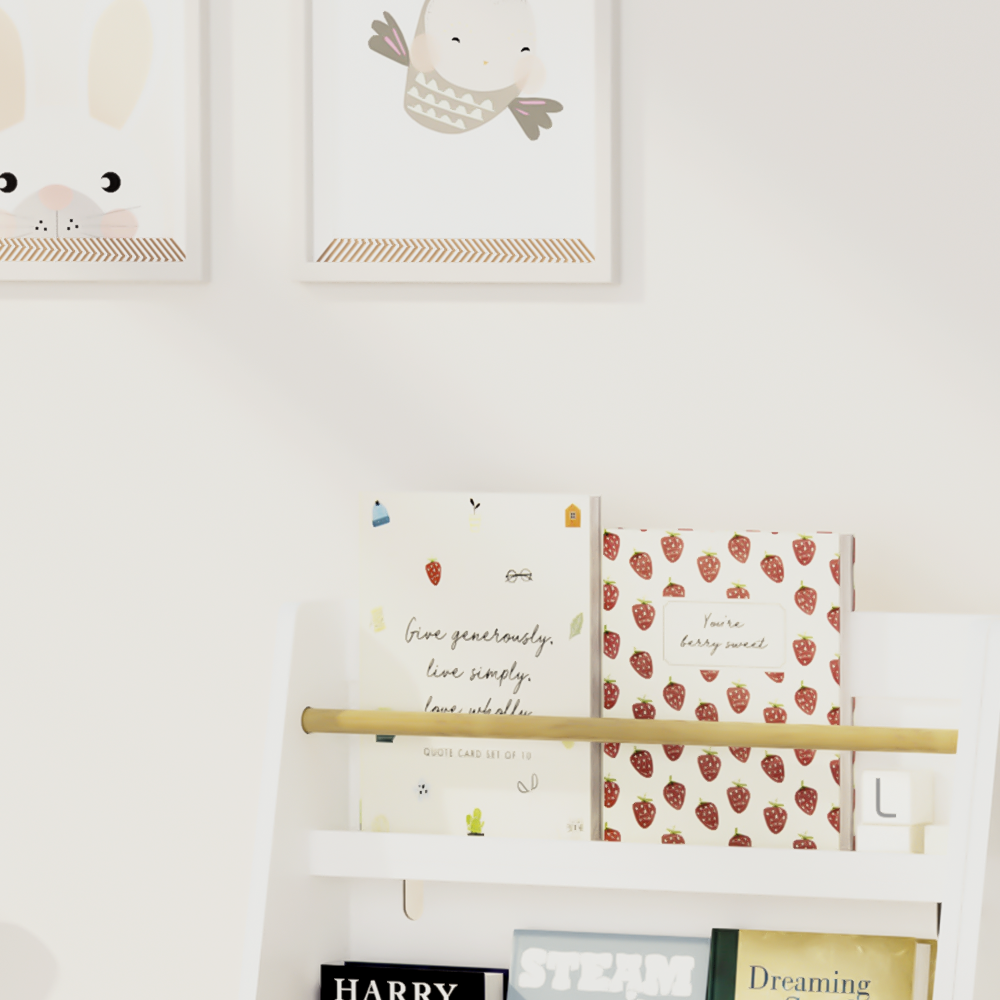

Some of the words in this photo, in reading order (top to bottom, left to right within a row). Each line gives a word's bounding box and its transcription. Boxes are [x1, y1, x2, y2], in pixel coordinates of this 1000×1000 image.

[405, 616, 447, 643] Give
[451, 624, 553, 657] generously.
[703, 613, 745, 628] You're
[680, 634, 722, 656] berry
[426, 658, 464, 678] live
[470, 661, 531, 694] simply.
[423, 747, 452, 758] QUOTE
[457, 748, 482, 759] CARD
[486, 749, 500, 759] SET
[504, 750, 516, 760] OF
[522, 751, 532, 761] 10
[876, 778, 896, 818] L
[518, 947, 695, 997] STEAM
